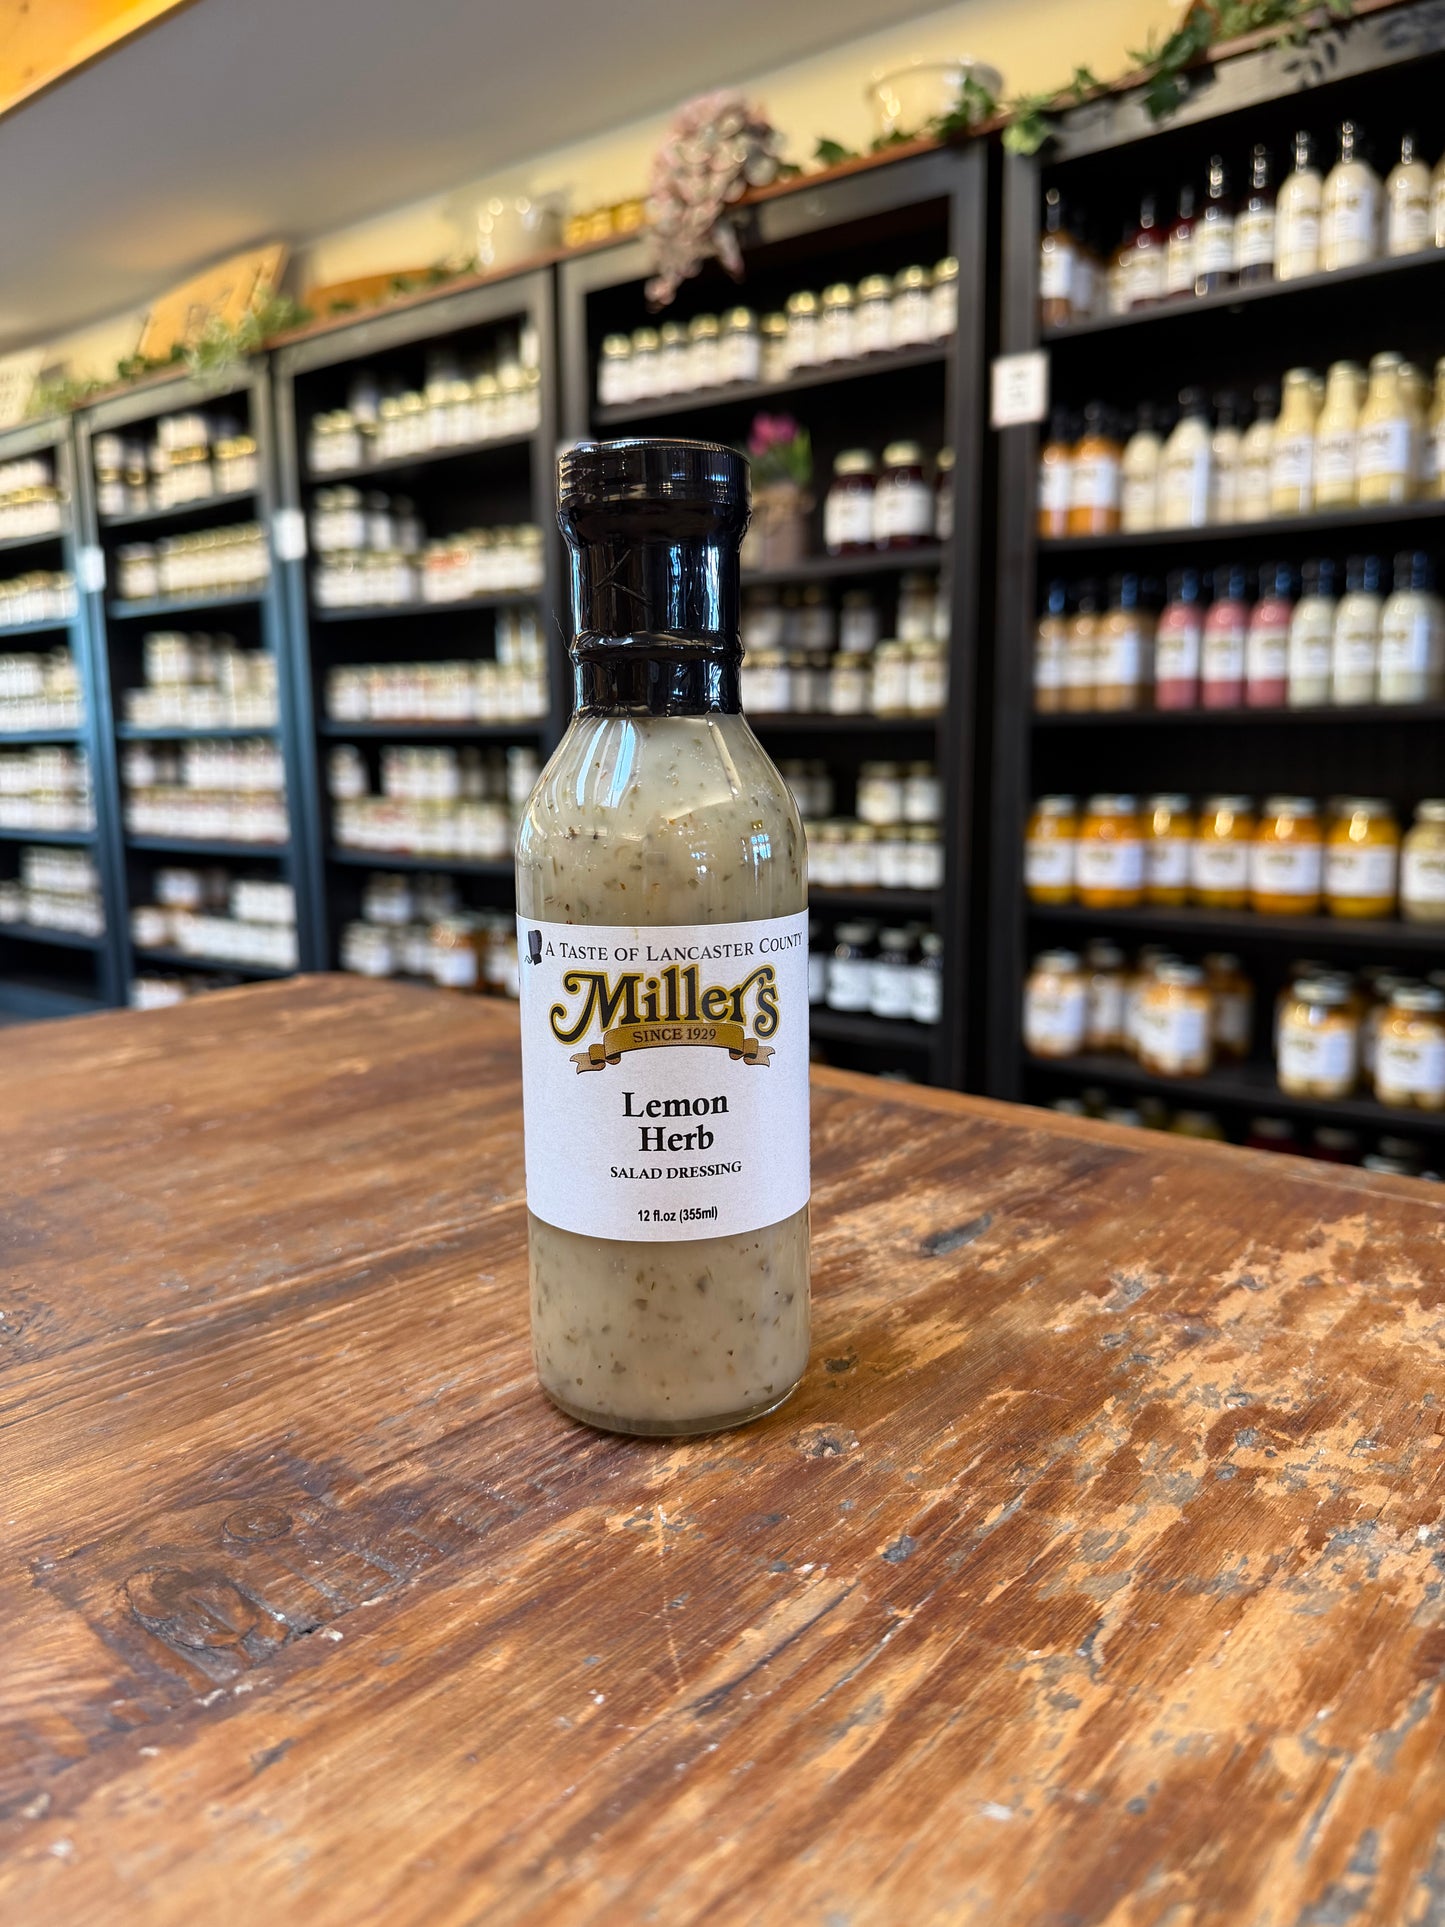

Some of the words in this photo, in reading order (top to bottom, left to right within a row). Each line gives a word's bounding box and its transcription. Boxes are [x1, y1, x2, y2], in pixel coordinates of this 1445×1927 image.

[545, 941, 555, 957] A
[560, 943, 609, 961] TASTE
[616, 947, 639, 961] OF
[647, 942, 754, 961] LANCASTER
[759, 932, 803, 954] COUNTY
[549, 964, 780, 1045] Miller's
[632, 1028, 683, 1043] SINCE
[687, 1028, 717, 1041] 1929
[622, 1091, 729, 1118] Lemon
[638, 1124, 714, 1152] Herb
[610, 1166, 663, 1180] SALAD
[666, 1161, 742, 1179] DRESSING
[638, 1210, 650, 1222] 12
[653, 1209, 676, 1222] fl.oz
[679, 1206, 718, 1223] (355ml)
